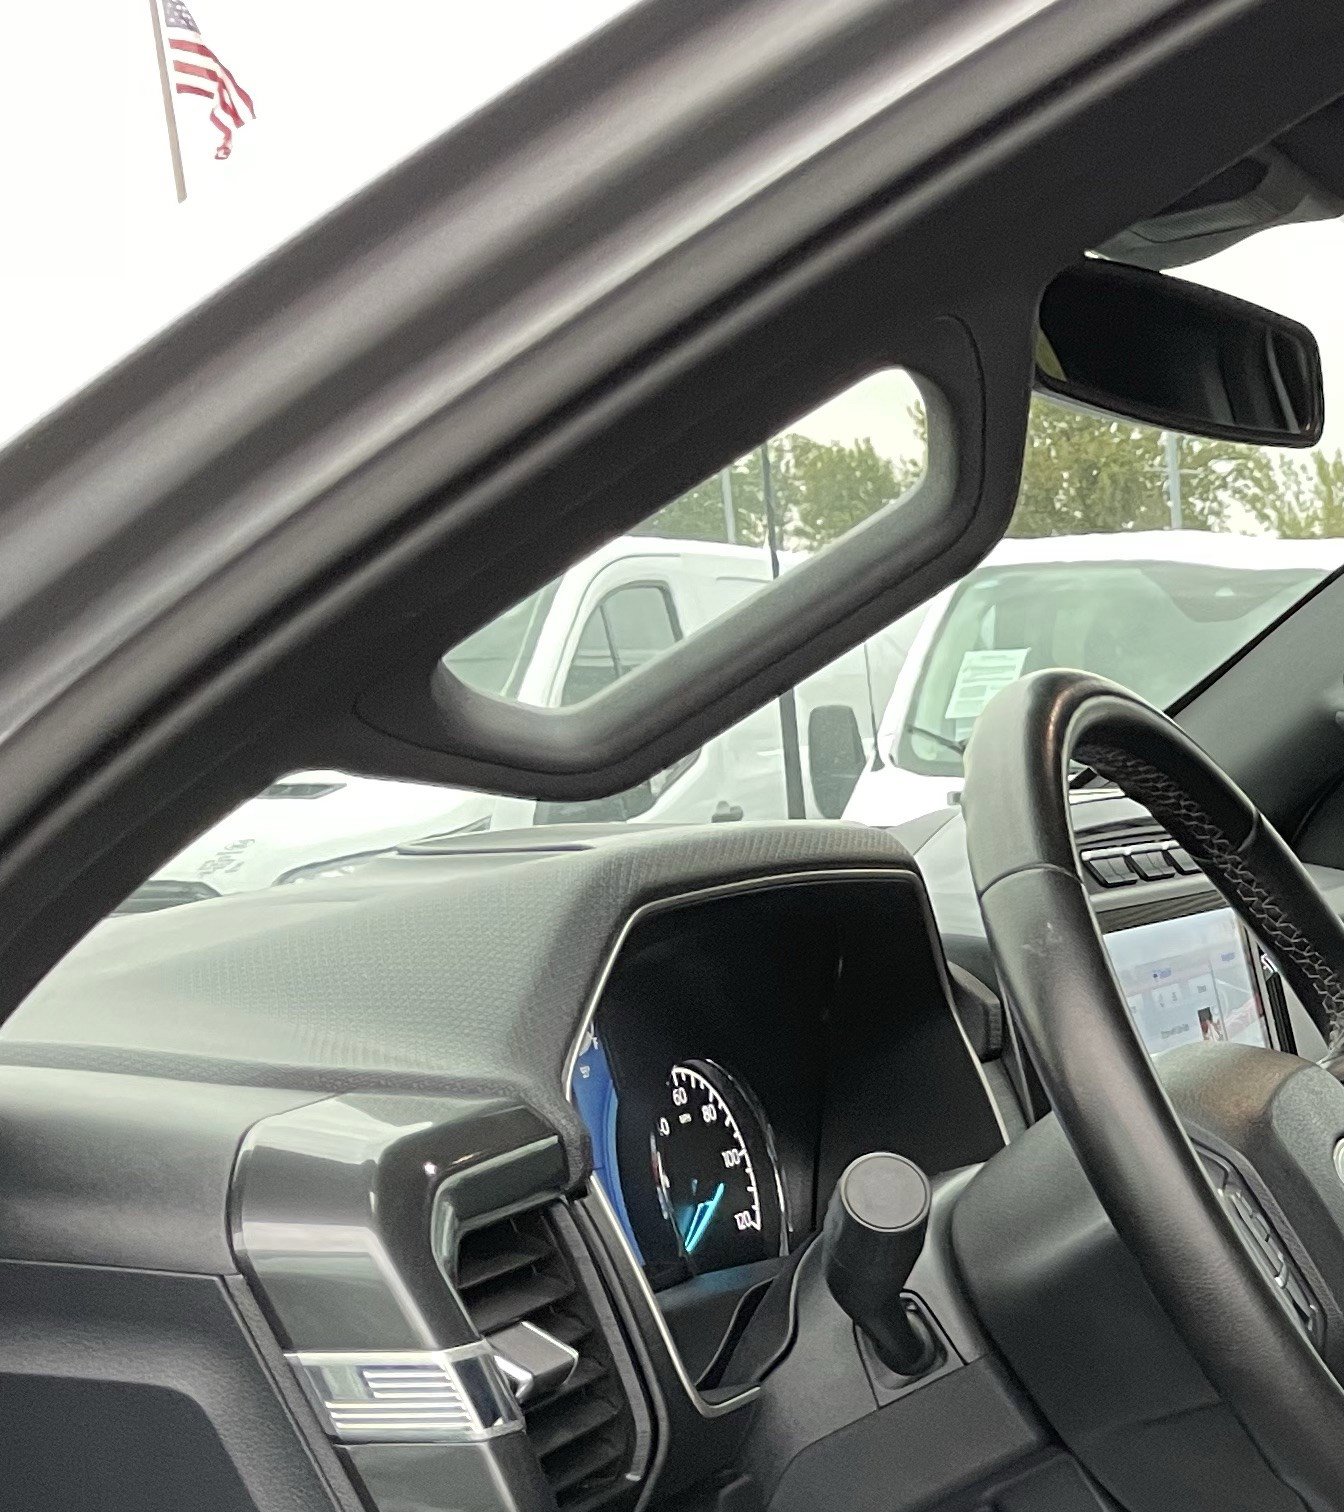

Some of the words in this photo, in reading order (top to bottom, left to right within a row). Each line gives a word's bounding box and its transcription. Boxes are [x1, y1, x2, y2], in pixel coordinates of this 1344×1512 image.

[673, 1087, 688, 1106] 60
[702, 1104, 717, 1122] 80
[721, 1148, 740, 1168] 100
[734, 1211, 752, 1230] 120
